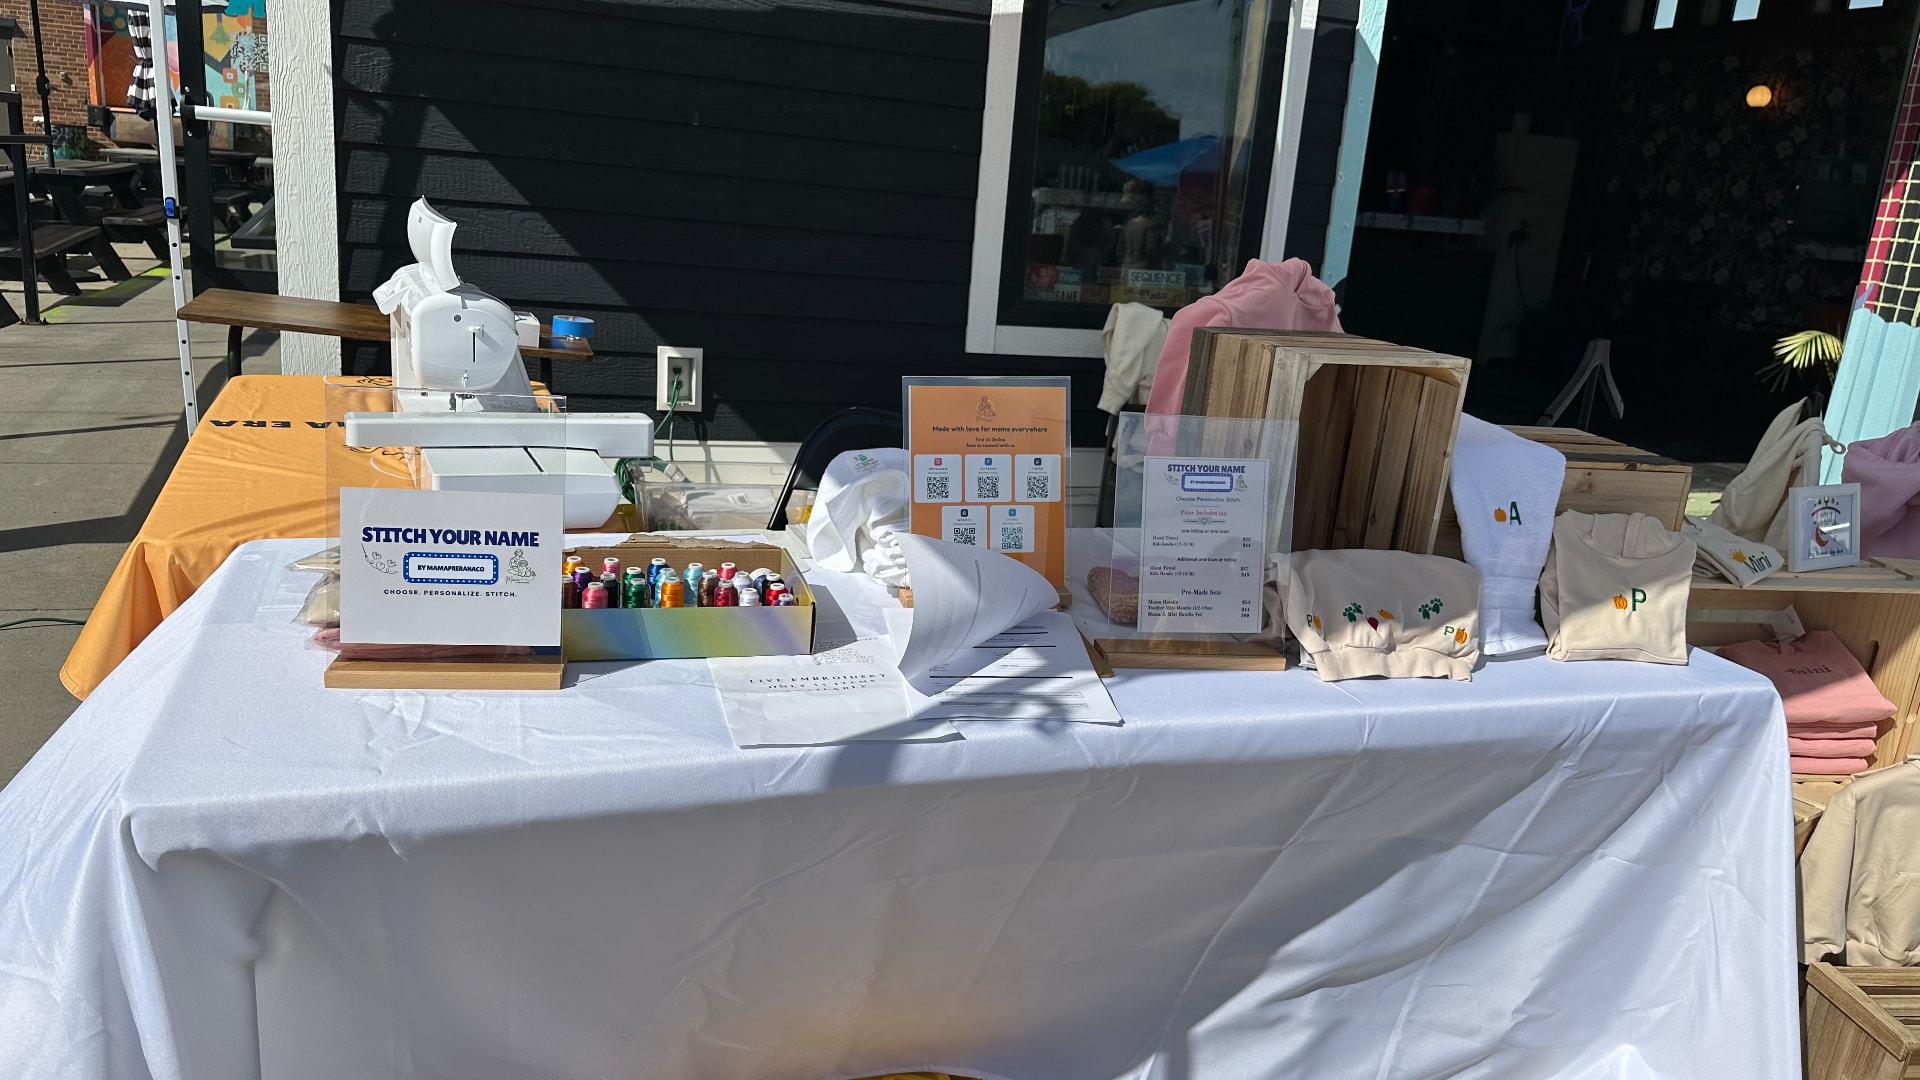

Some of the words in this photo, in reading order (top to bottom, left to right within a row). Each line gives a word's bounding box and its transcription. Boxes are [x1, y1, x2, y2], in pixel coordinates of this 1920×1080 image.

[1130, 271, 1182, 285] SEQUENCE
[1055, 290, 1078, 302] GAME
[209, 420, 292, 428] ERA
[1011, 426, 1048, 434] everywhere
[1167, 464, 1196, 472] STITCH
[1197, 464, 1220, 473] YOUR
[1221, 465, 1246, 474] NAME
[1508, 501, 1523, 526] A
[362, 526, 427, 544] STITCH
[429, 528, 482, 546] YOUR
[484, 531, 540, 547] NAME
[1743, 551, 1772, 575] Mini
[383, 588, 421, 596] CHOOSE.
[1631, 587, 1648, 612] P
[1306, 613, 1313, 628] P
[1444, 625, 1454, 636] P
[791, 673, 887, 682] EMBROIDERY
